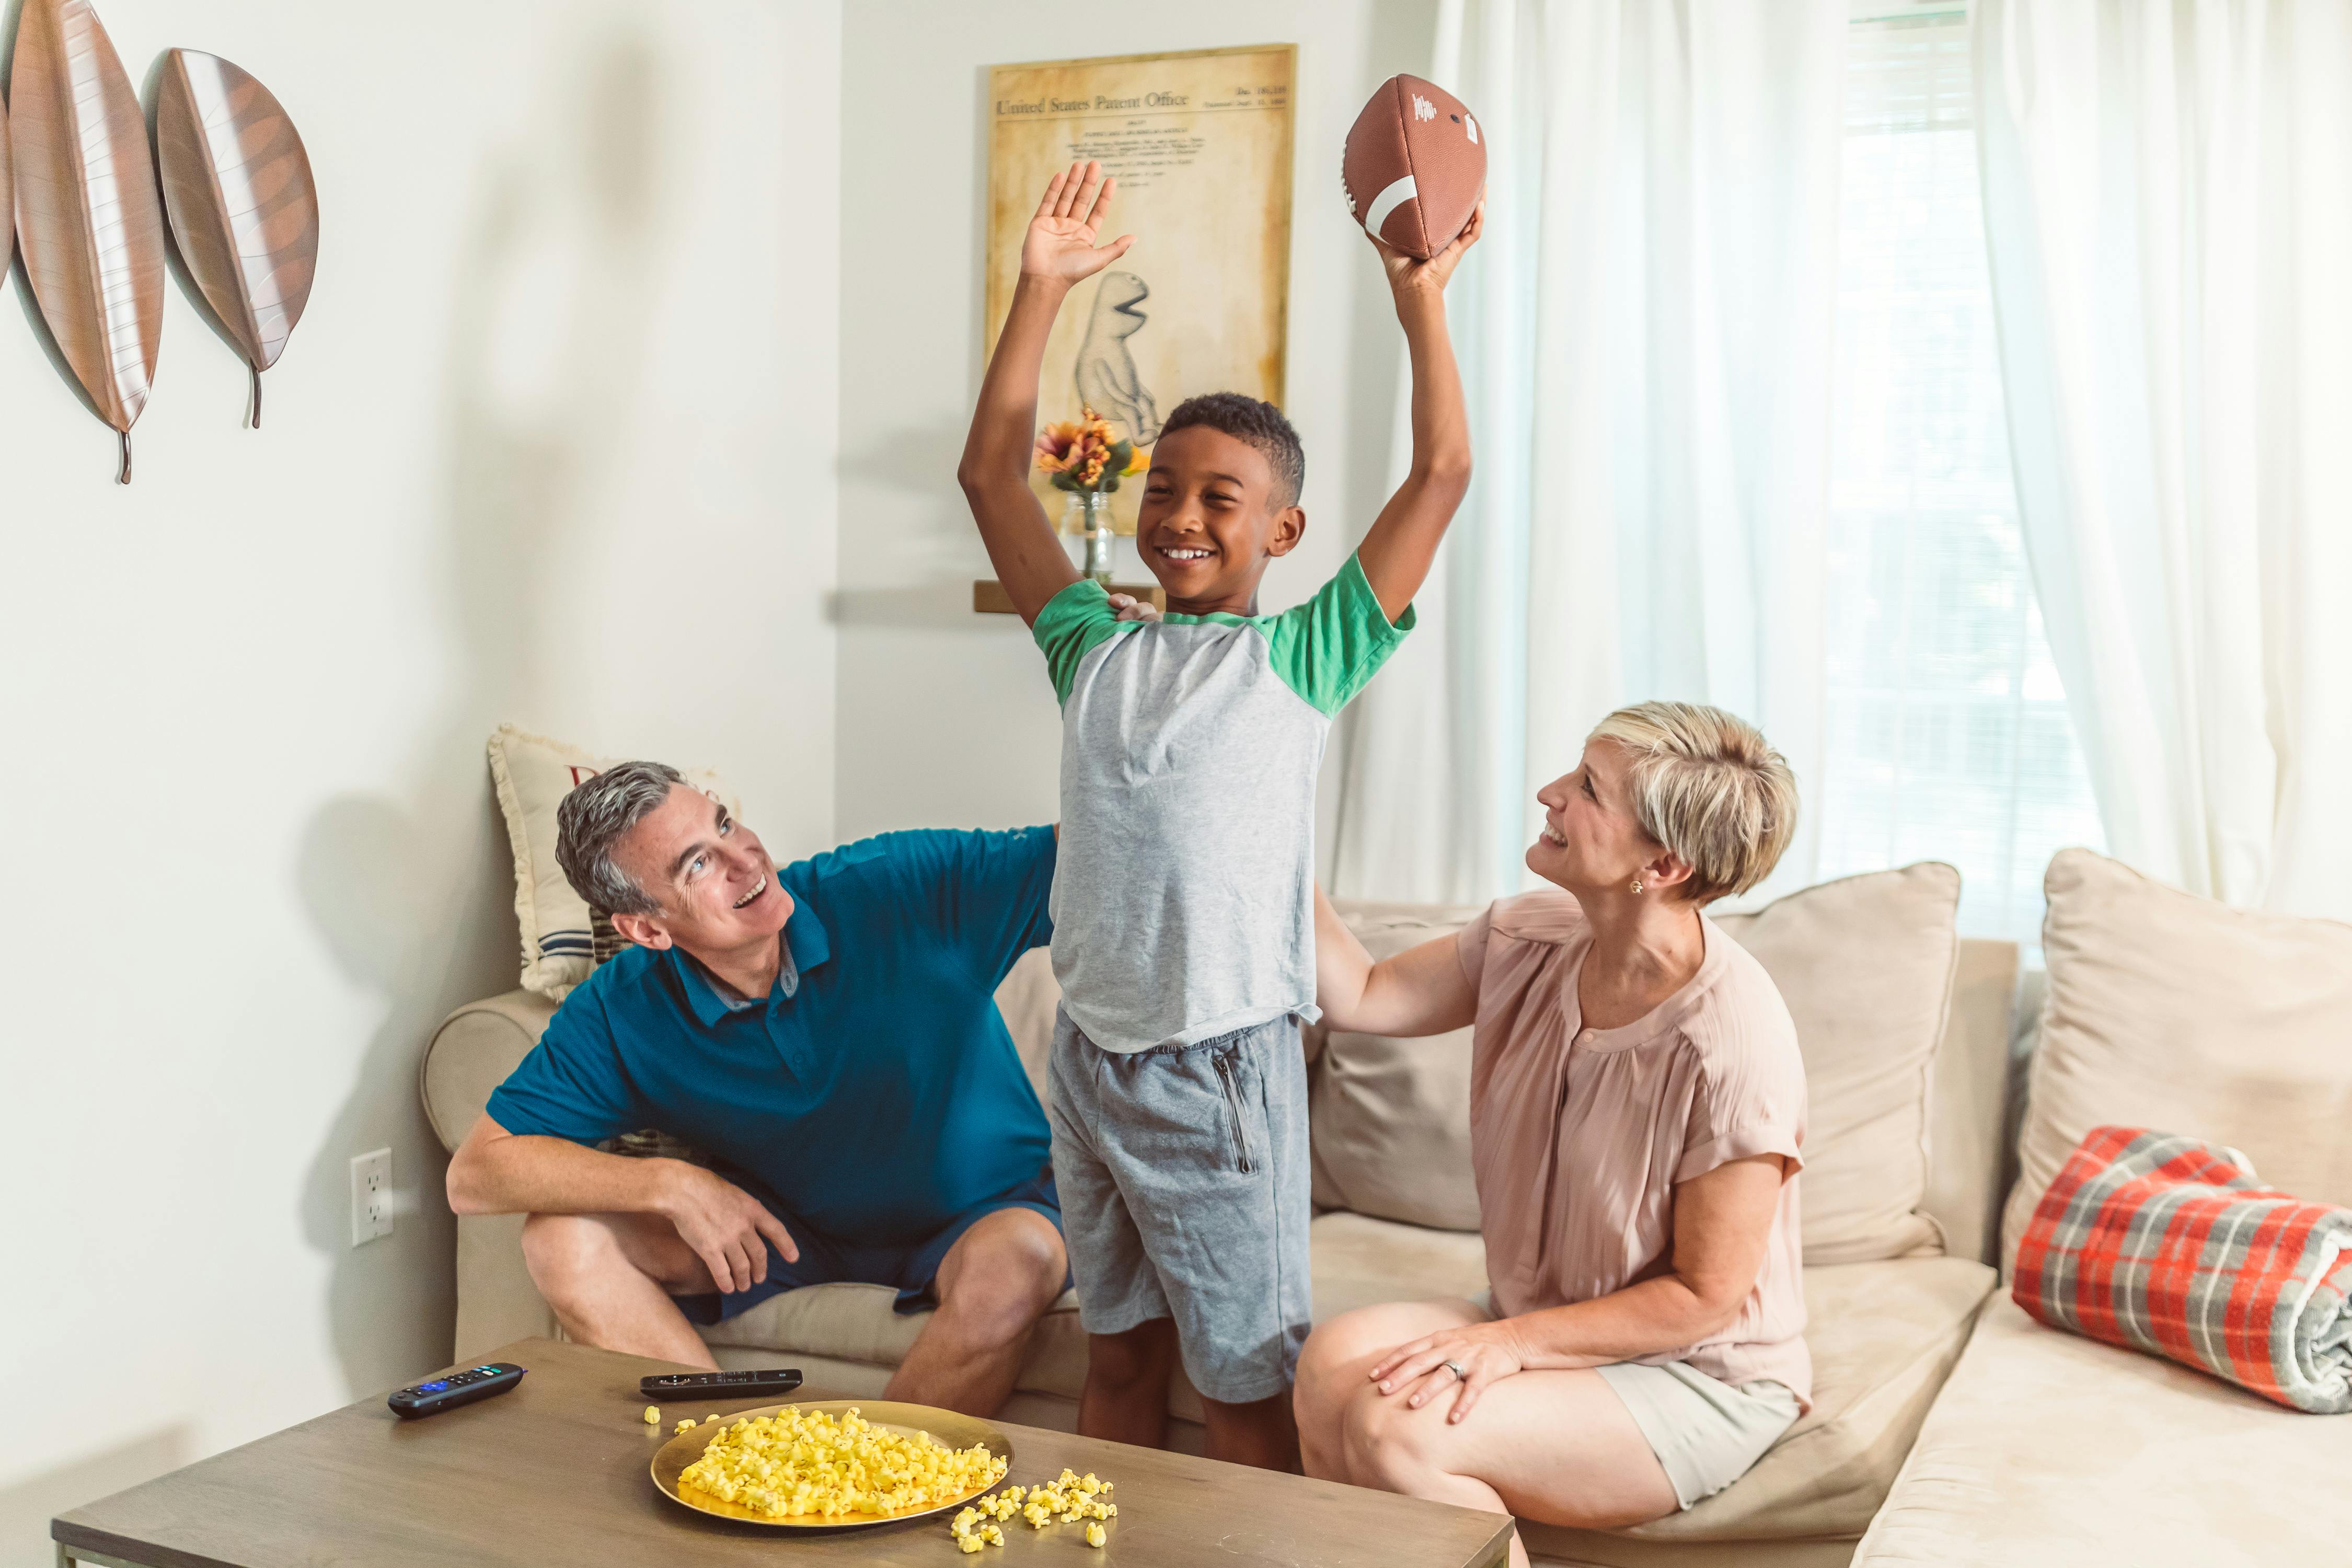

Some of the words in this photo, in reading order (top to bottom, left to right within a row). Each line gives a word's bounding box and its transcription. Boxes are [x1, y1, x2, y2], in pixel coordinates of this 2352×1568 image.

[996, 98, 1045, 114] United
[1049, 97, 1091, 112] States
[1095, 95, 1141, 109] Patent
[1145, 91, 1190, 106] Office
